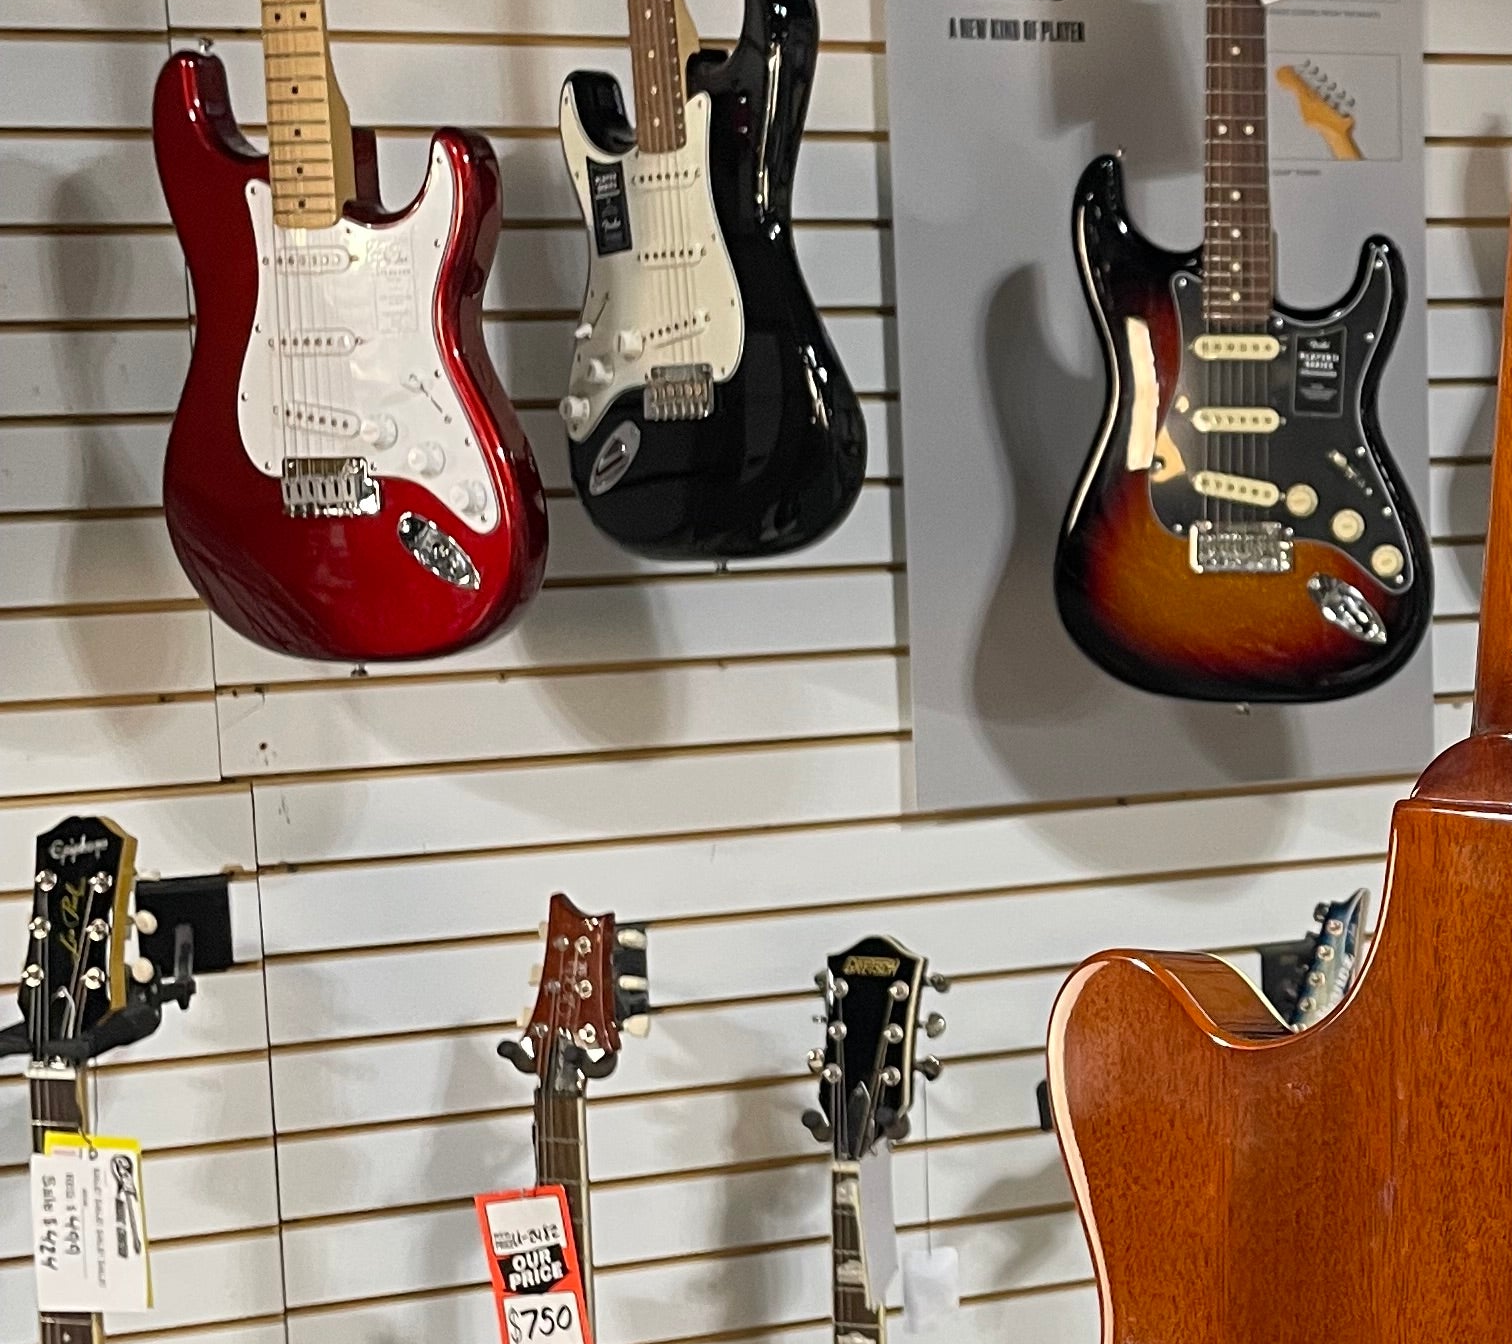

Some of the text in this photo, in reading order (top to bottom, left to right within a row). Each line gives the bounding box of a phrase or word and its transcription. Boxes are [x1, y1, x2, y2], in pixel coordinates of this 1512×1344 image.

[1041, 20, 1085, 43] PLAYER
[40, 1174, 59, 1212] Sale
[511, 1248, 552, 1273] OUR
[508, 1260, 564, 1292] PRICE
